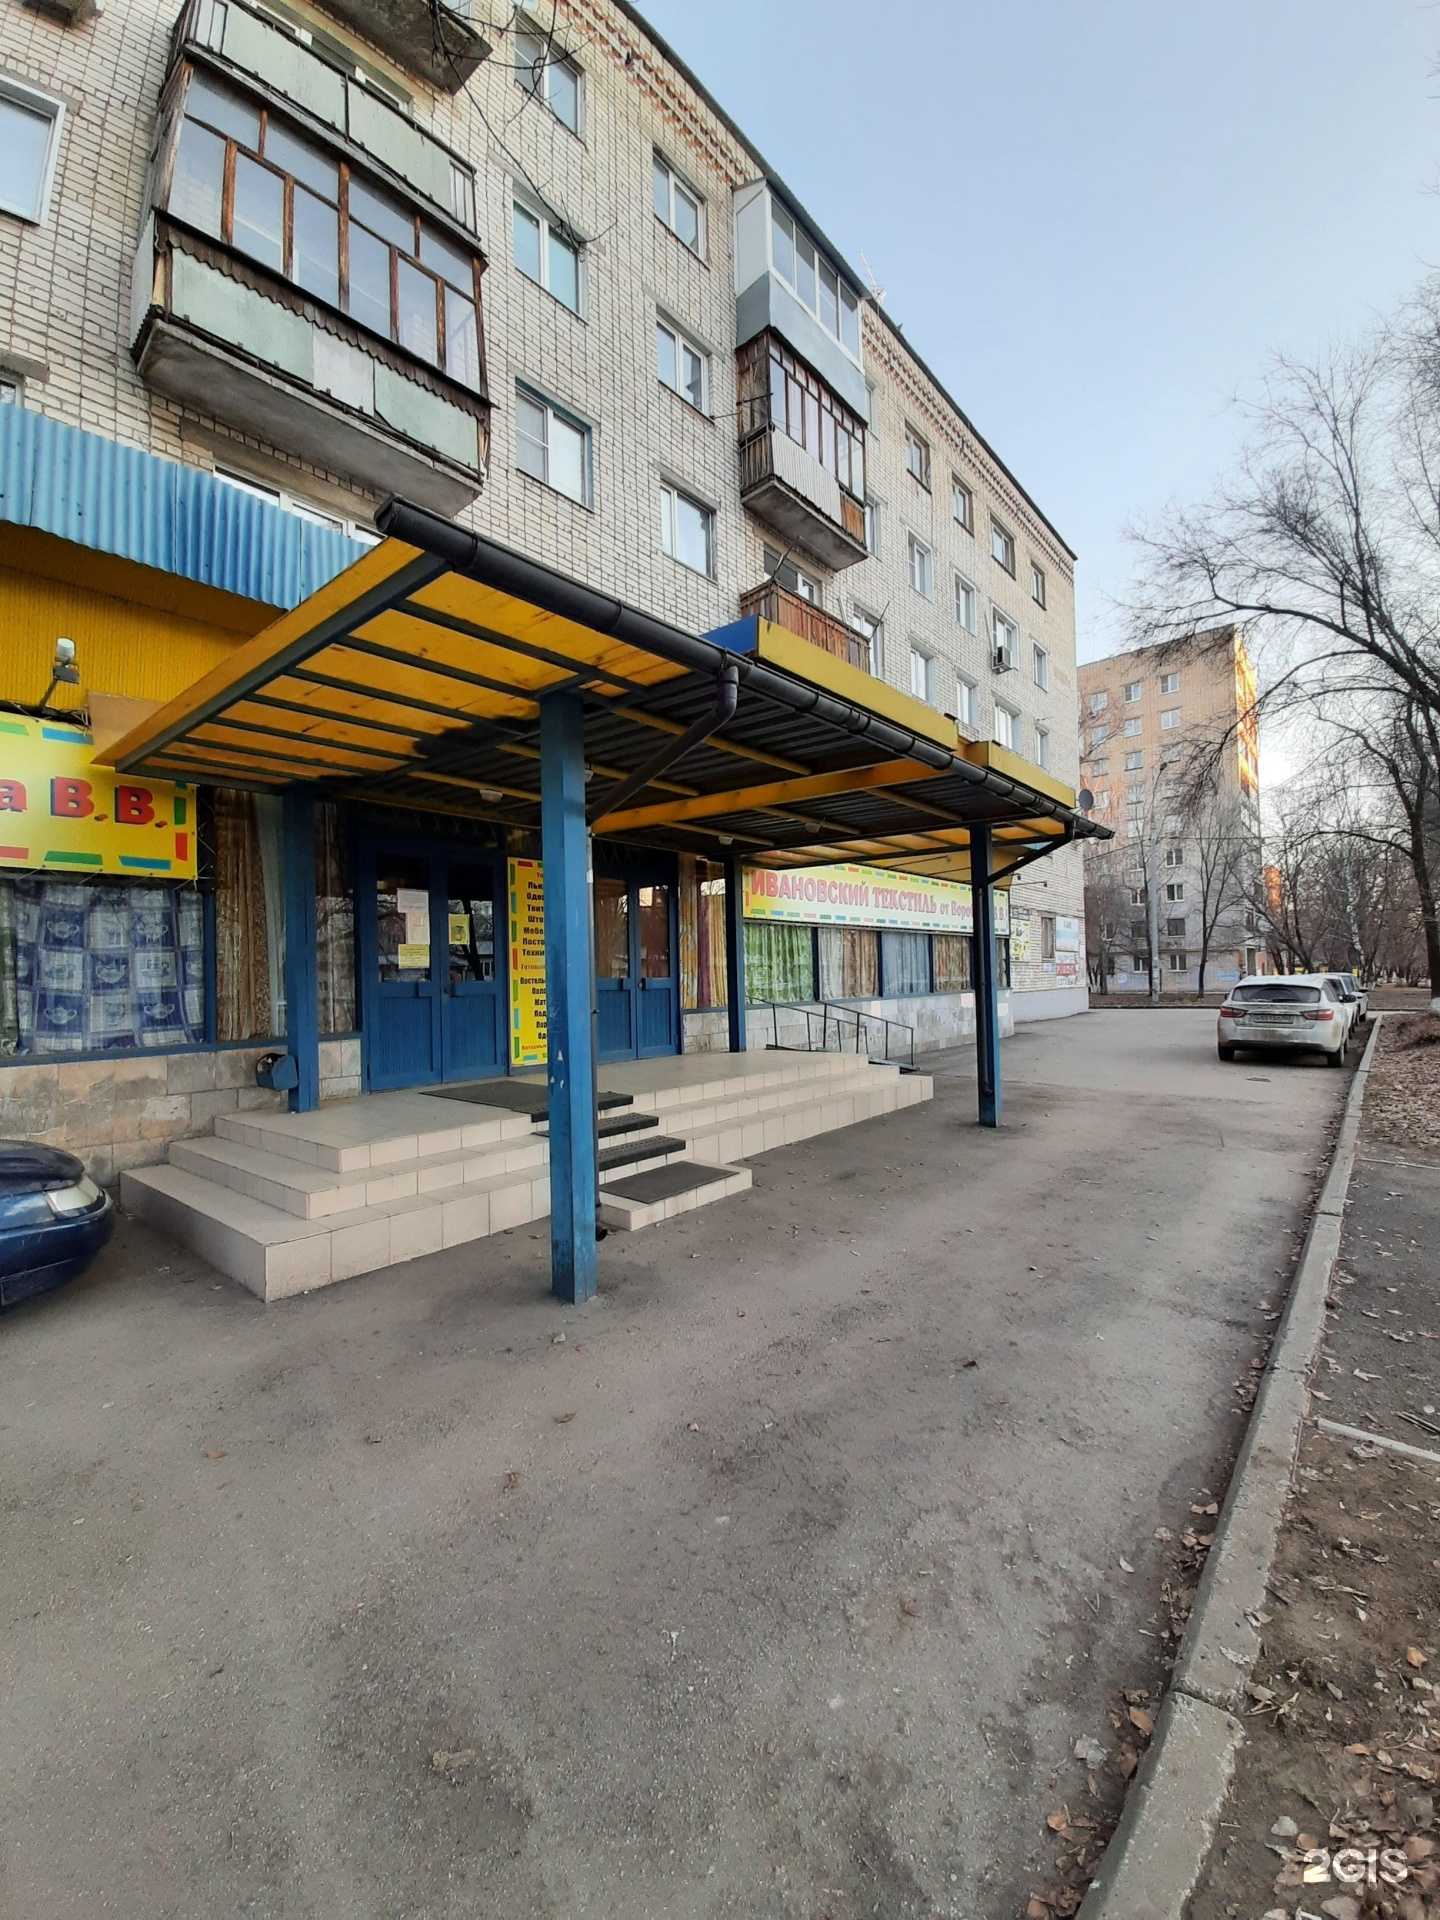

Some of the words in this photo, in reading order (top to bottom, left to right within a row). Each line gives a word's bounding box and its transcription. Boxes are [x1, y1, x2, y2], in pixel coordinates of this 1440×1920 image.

[751, 869, 869, 907] ИВАНОВСКИЙ
[872, 886, 937, 914] ТЕКСТИЛЬ
[940, 902, 950, 915] от
